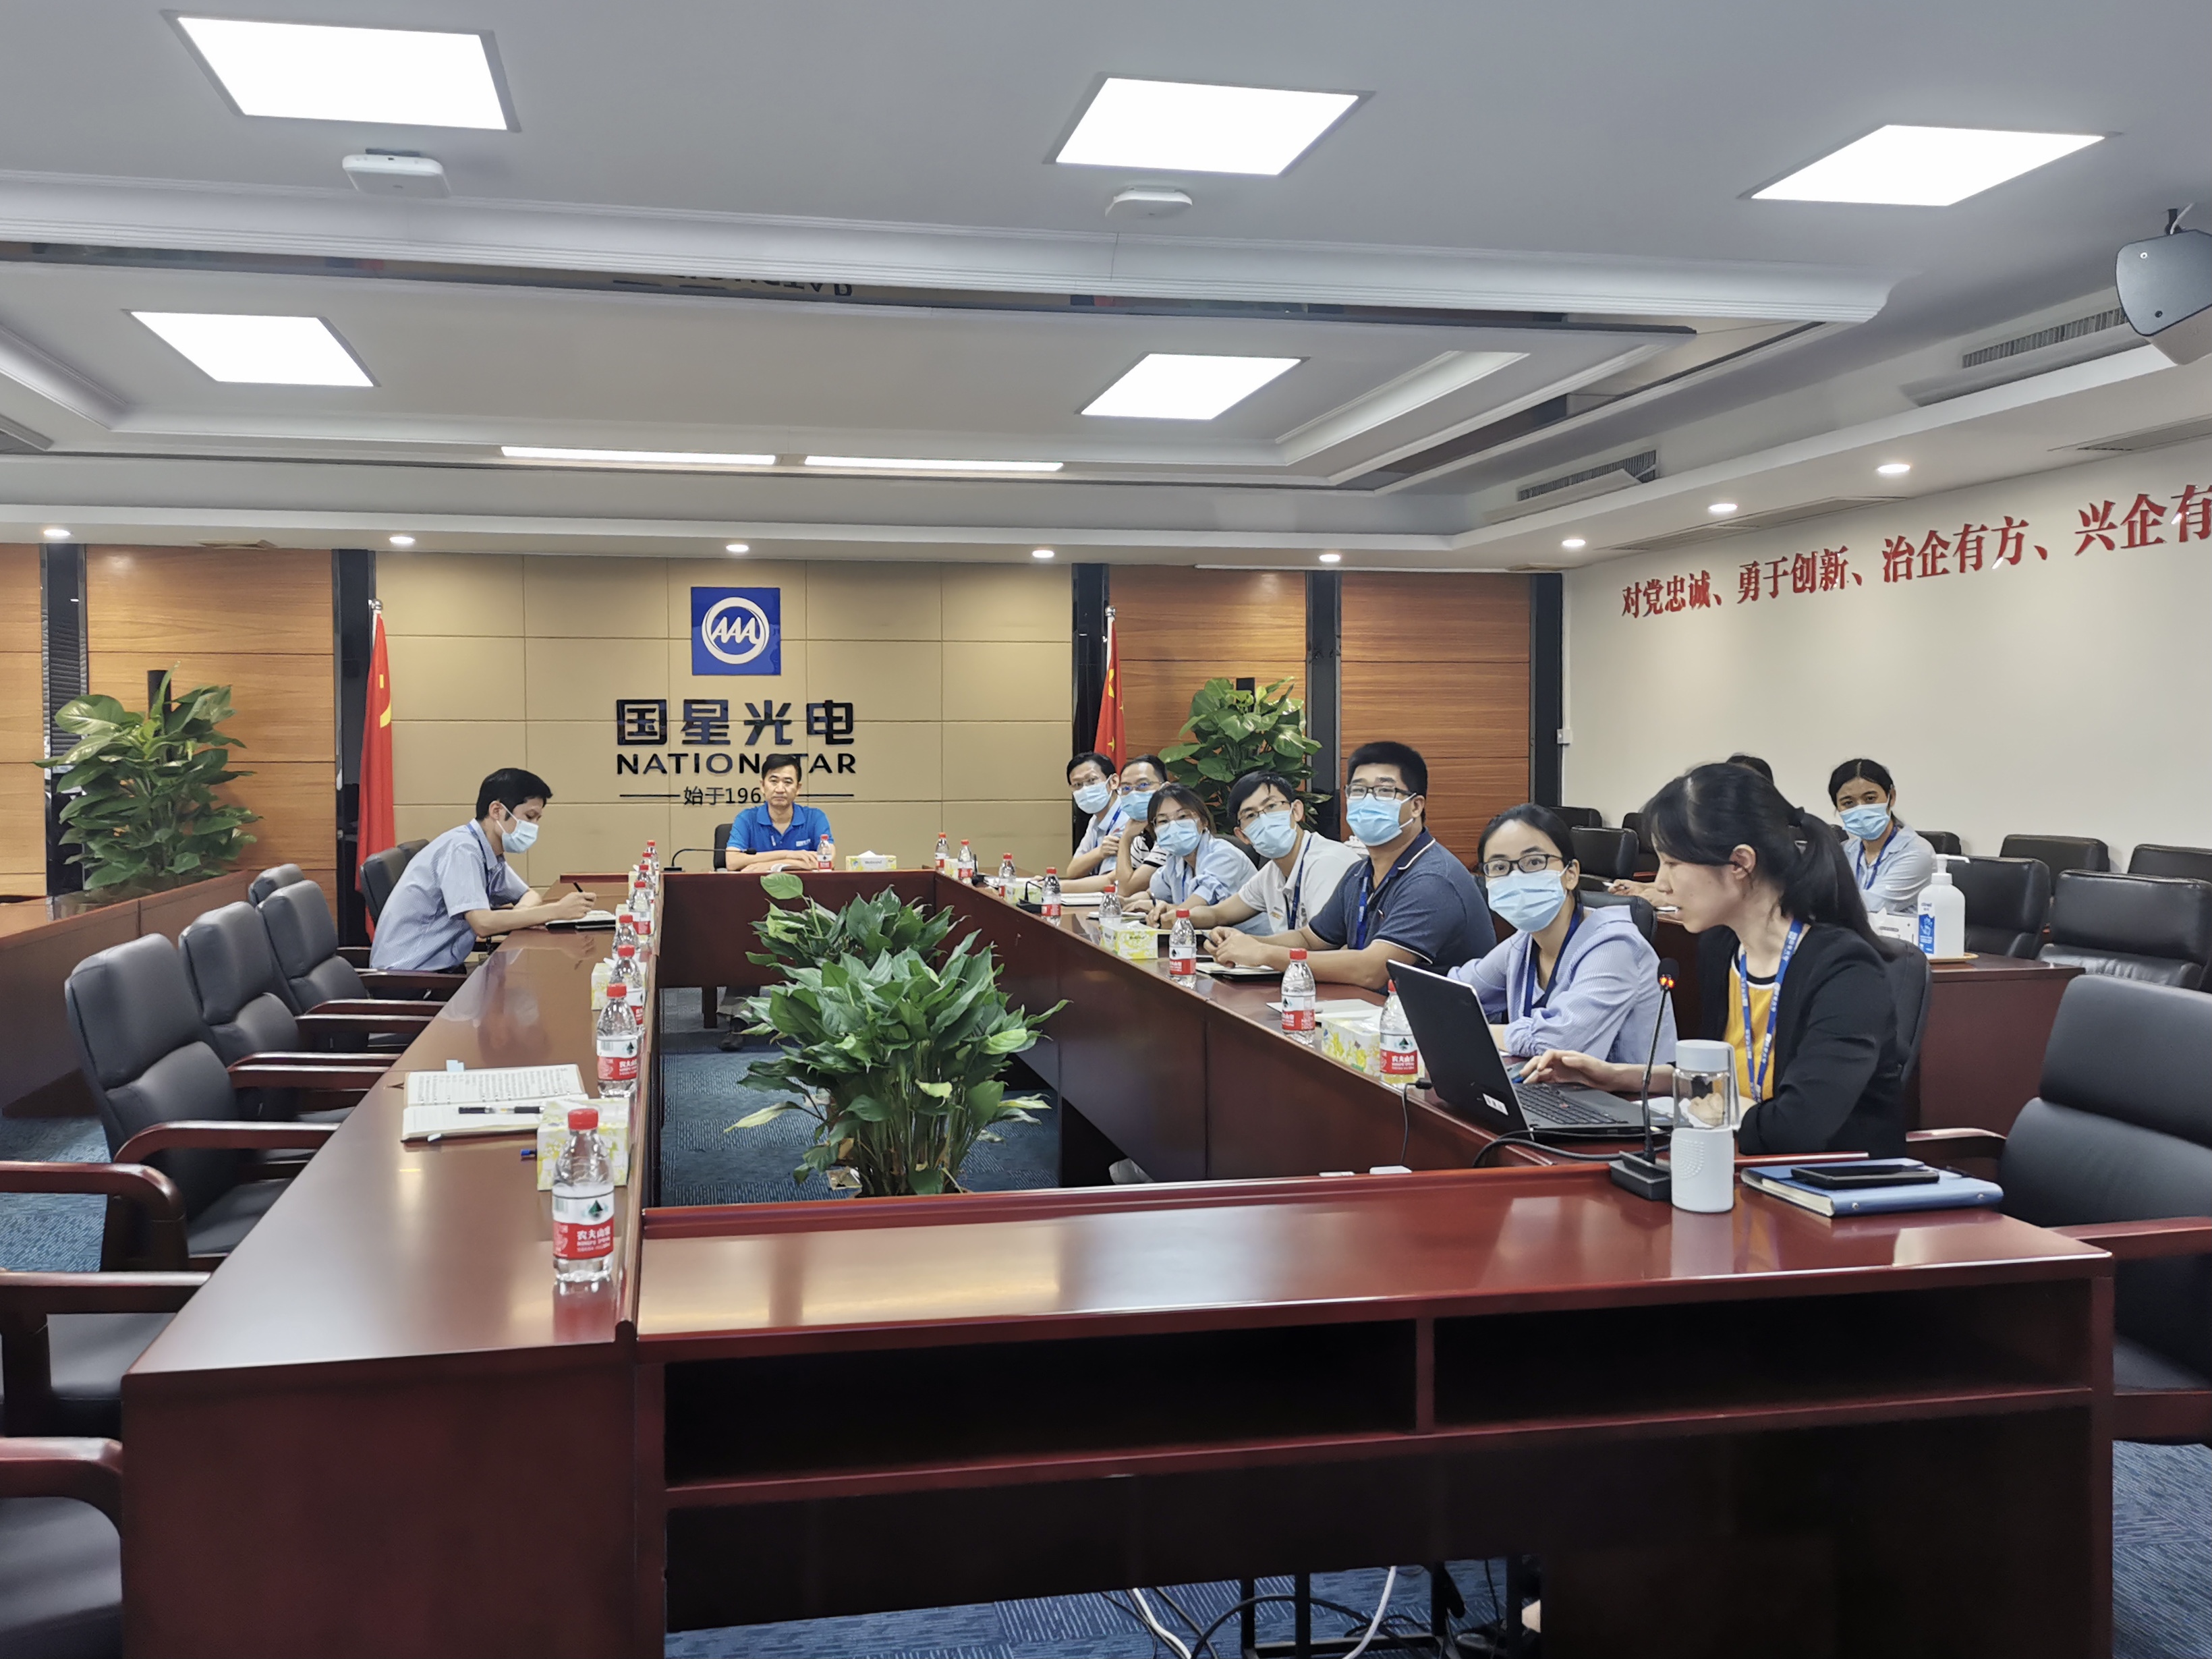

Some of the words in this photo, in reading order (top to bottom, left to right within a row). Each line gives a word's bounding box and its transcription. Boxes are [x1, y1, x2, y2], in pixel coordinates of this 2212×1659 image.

[616, 699, 855, 746] 国星光电
[617, 753, 856, 775] NATIONTAR
[683, 786, 766, 805] 始于196
